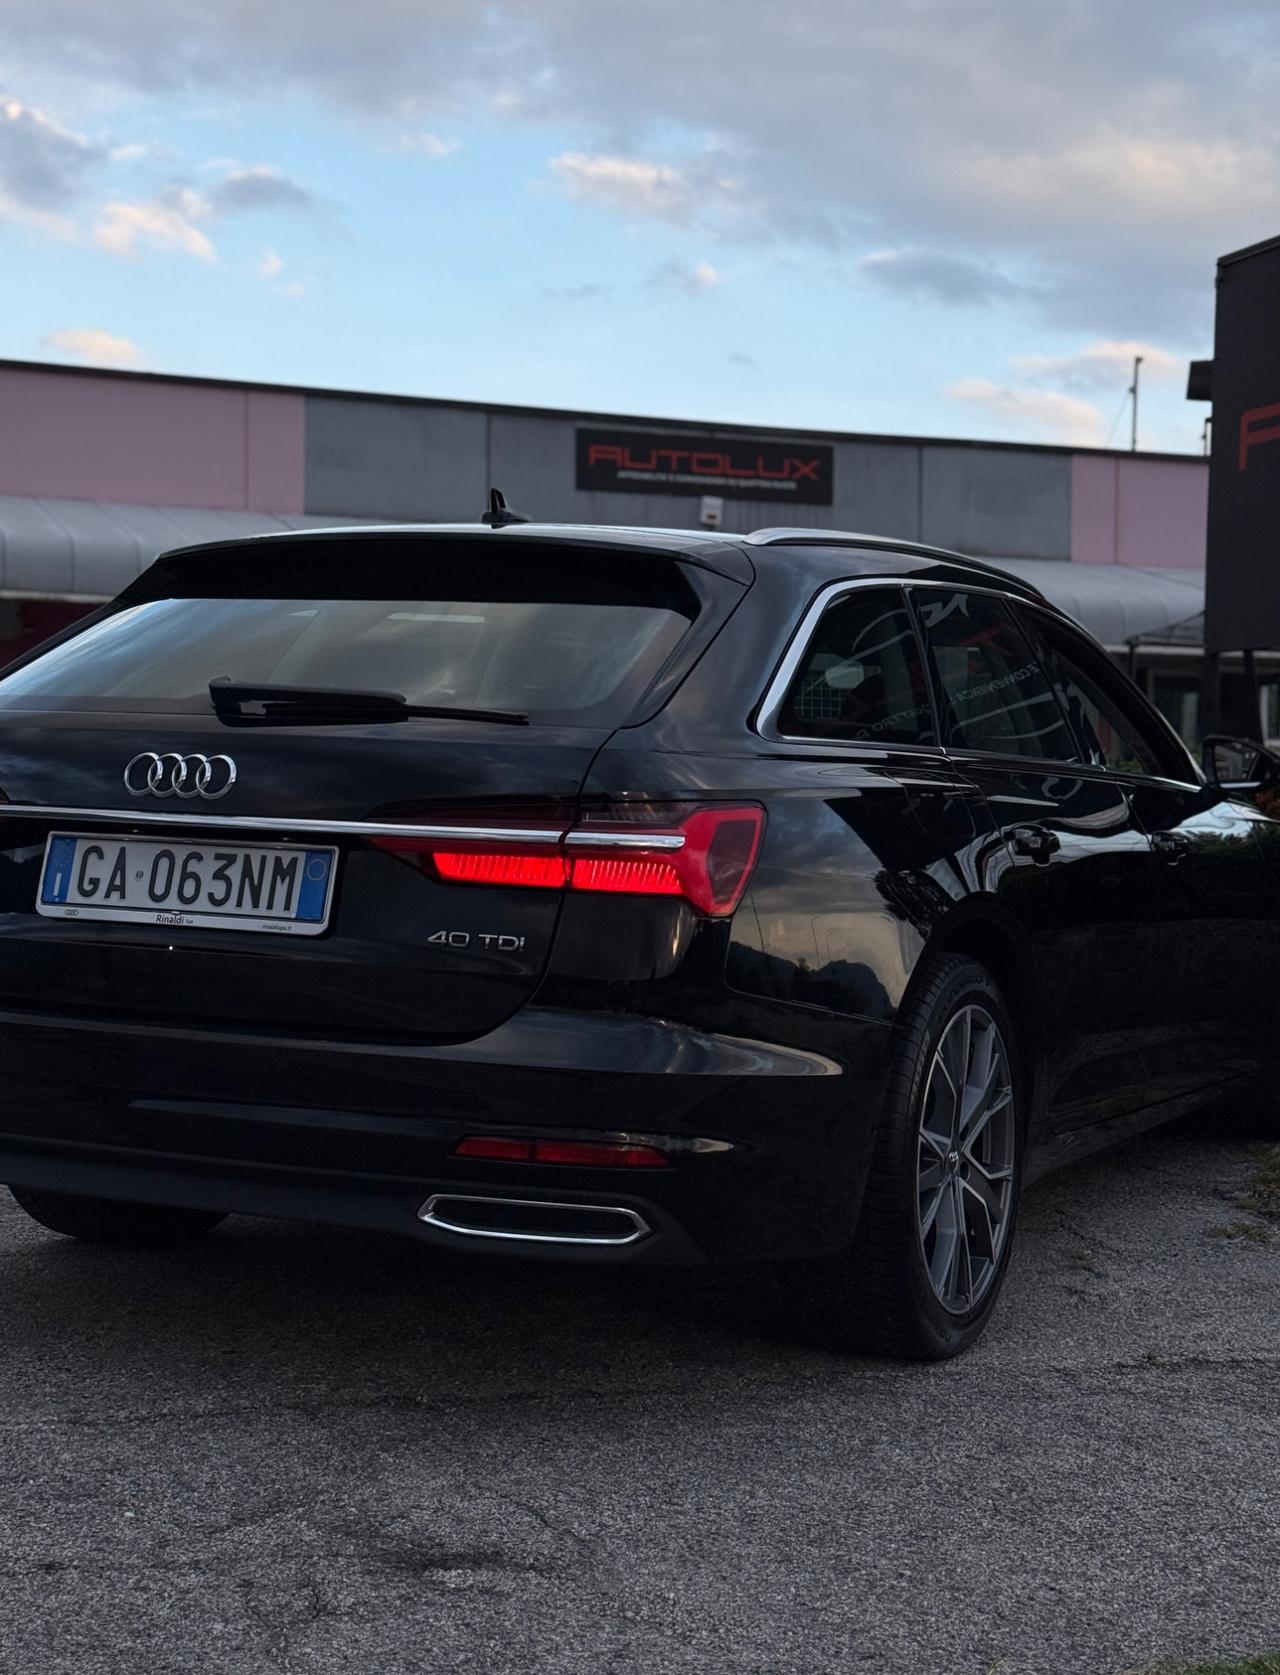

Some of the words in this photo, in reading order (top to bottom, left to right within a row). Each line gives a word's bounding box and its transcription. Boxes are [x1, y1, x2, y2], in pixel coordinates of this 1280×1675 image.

[588, 445, 821, 481] AUTOLUX
[77, 845, 126, 900] GA
[148, 850, 299, 911] 063NM
[156, 914, 185, 926] Rinaldi
[427, 930, 470, 947] 40
[478, 934, 525, 952] TDI
